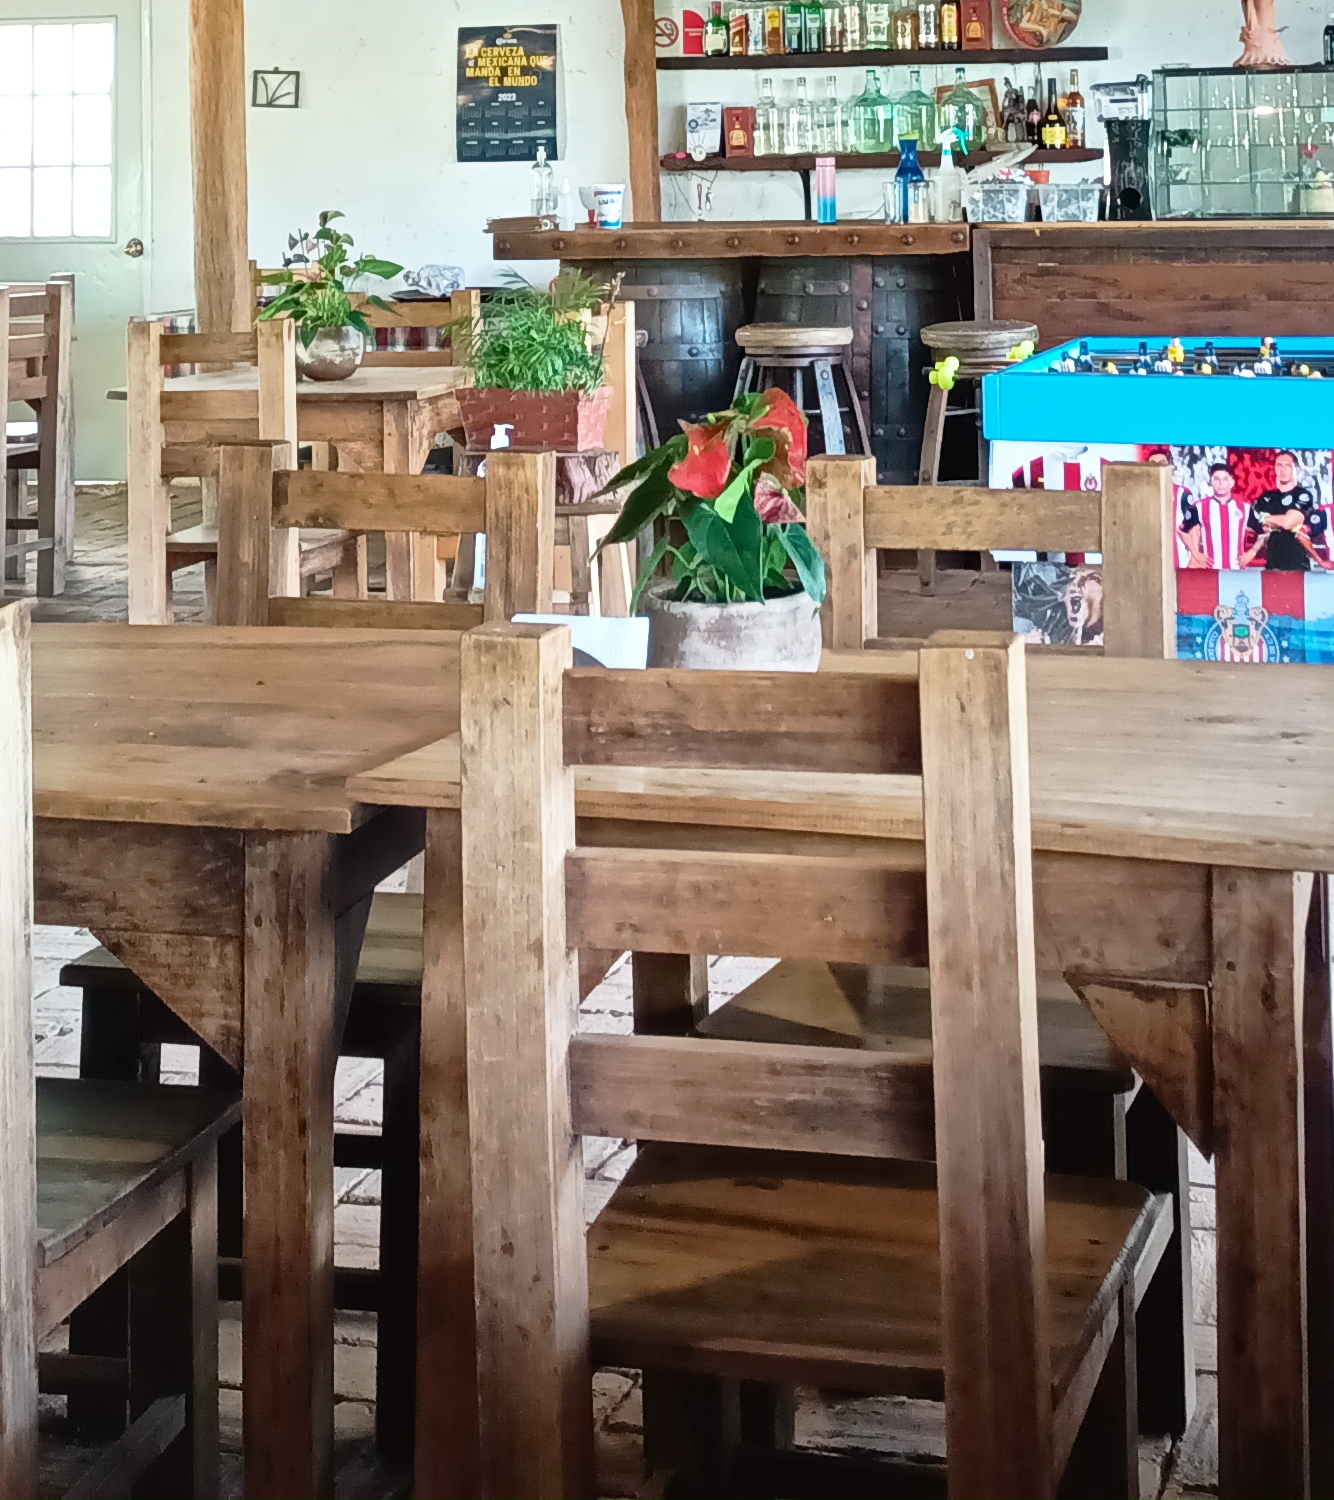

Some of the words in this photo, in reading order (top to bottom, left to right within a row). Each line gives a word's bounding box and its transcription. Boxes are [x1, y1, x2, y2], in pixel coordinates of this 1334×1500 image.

[465, 47, 479, 58] LA
[480, 46, 525, 57] CERVEZA
[477, 56, 528, 67] MEXICANA
[529, 55, 551, 67] QUE
[465, 67, 501, 78] MANDA
[507, 66, 521, 76] EN
[488, 77, 501, 87] EL
[503, 76, 538, 87] MUNDO
[497, 93, 517, 102] 2023
